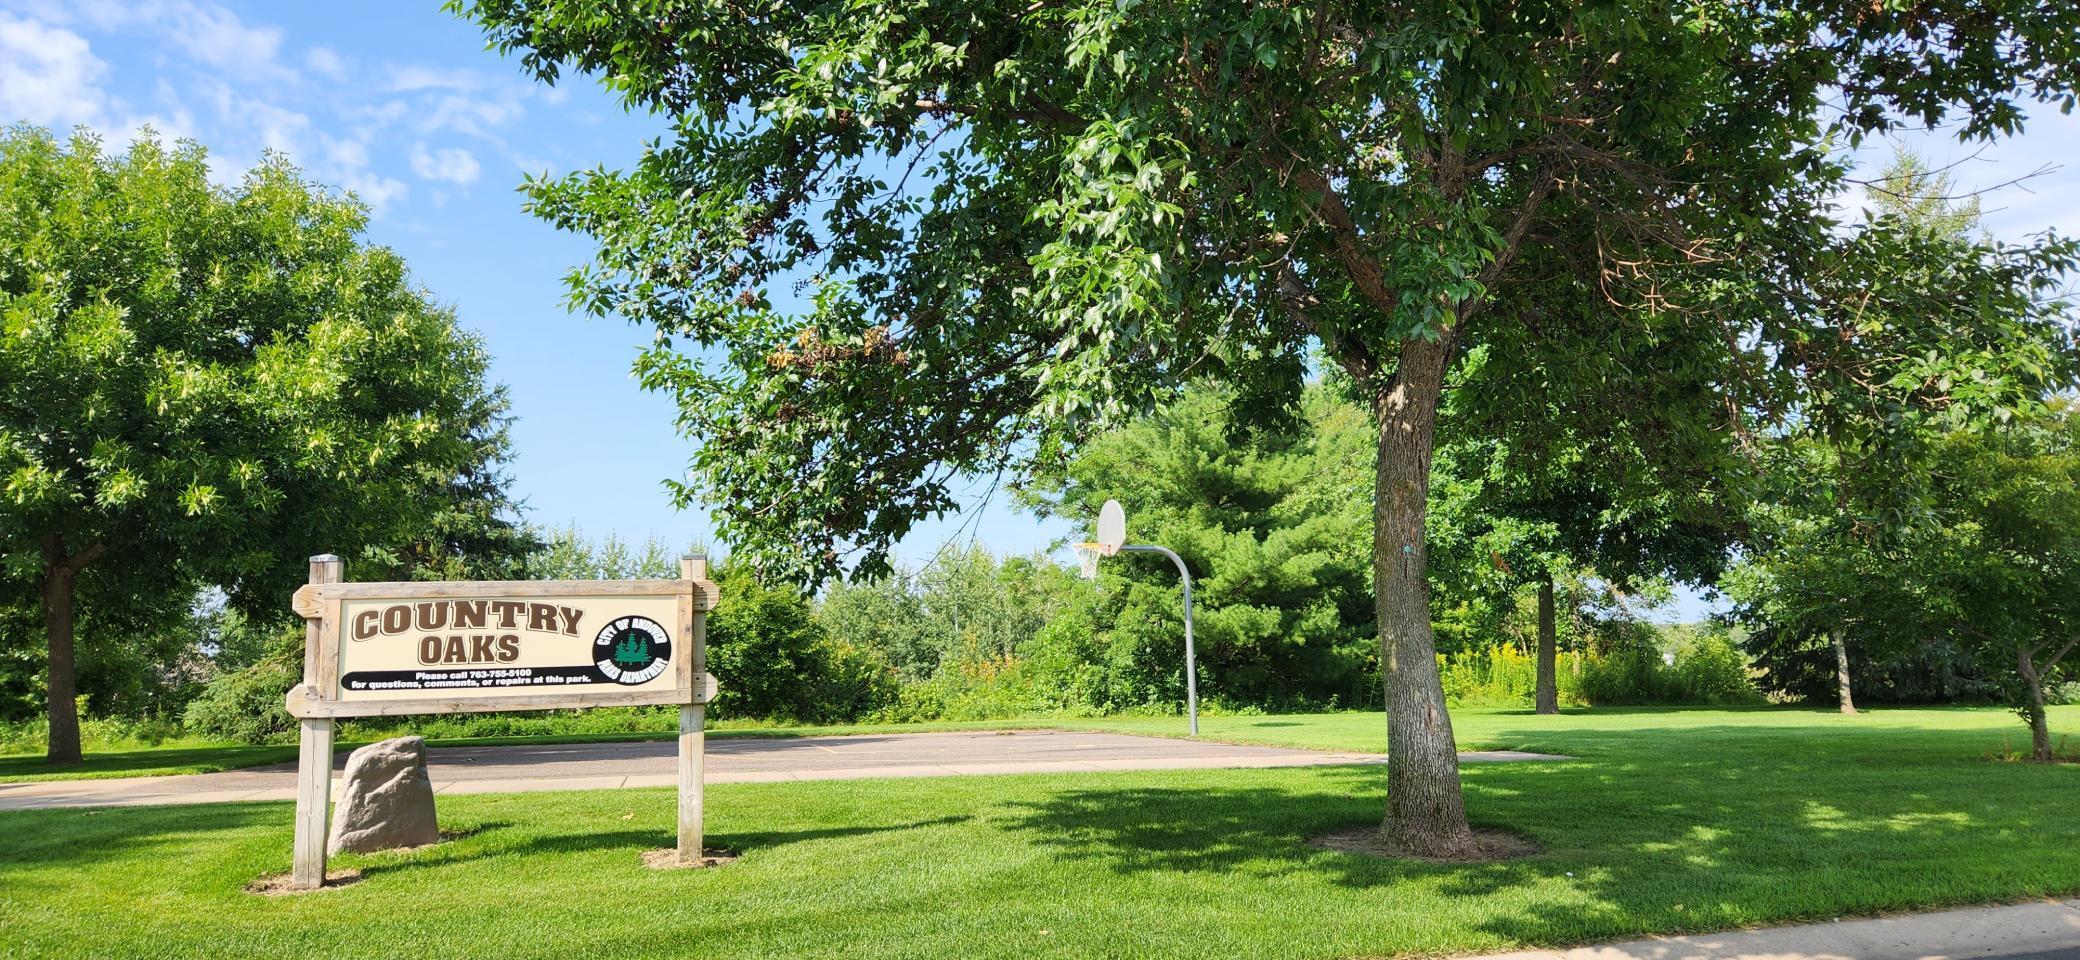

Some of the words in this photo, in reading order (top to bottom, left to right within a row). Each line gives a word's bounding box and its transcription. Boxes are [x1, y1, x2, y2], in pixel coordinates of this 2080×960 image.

[353, 600, 585, 641] COUNTRY
[597, 625, 618, 645] CITY
[615, 618, 629, 631] OF
[632, 618, 668, 644] ANDOVER
[418, 635, 520, 665] OAKS
[351, 680, 367, 689] for
[369, 680, 422, 690] questions,
[424, 679, 480, 688] comments,
[495, 676, 531, 687] repairs
[533, 676, 544, 684] at
[545, 674, 564, 683] this
[566, 674, 592, 685] park.
[416, 672, 448, 681] Please
[450, 671, 467, 680] call
[469, 669, 532, 679] 763-755-5100
[619, 657, 669, 683] DEPARTMENT
